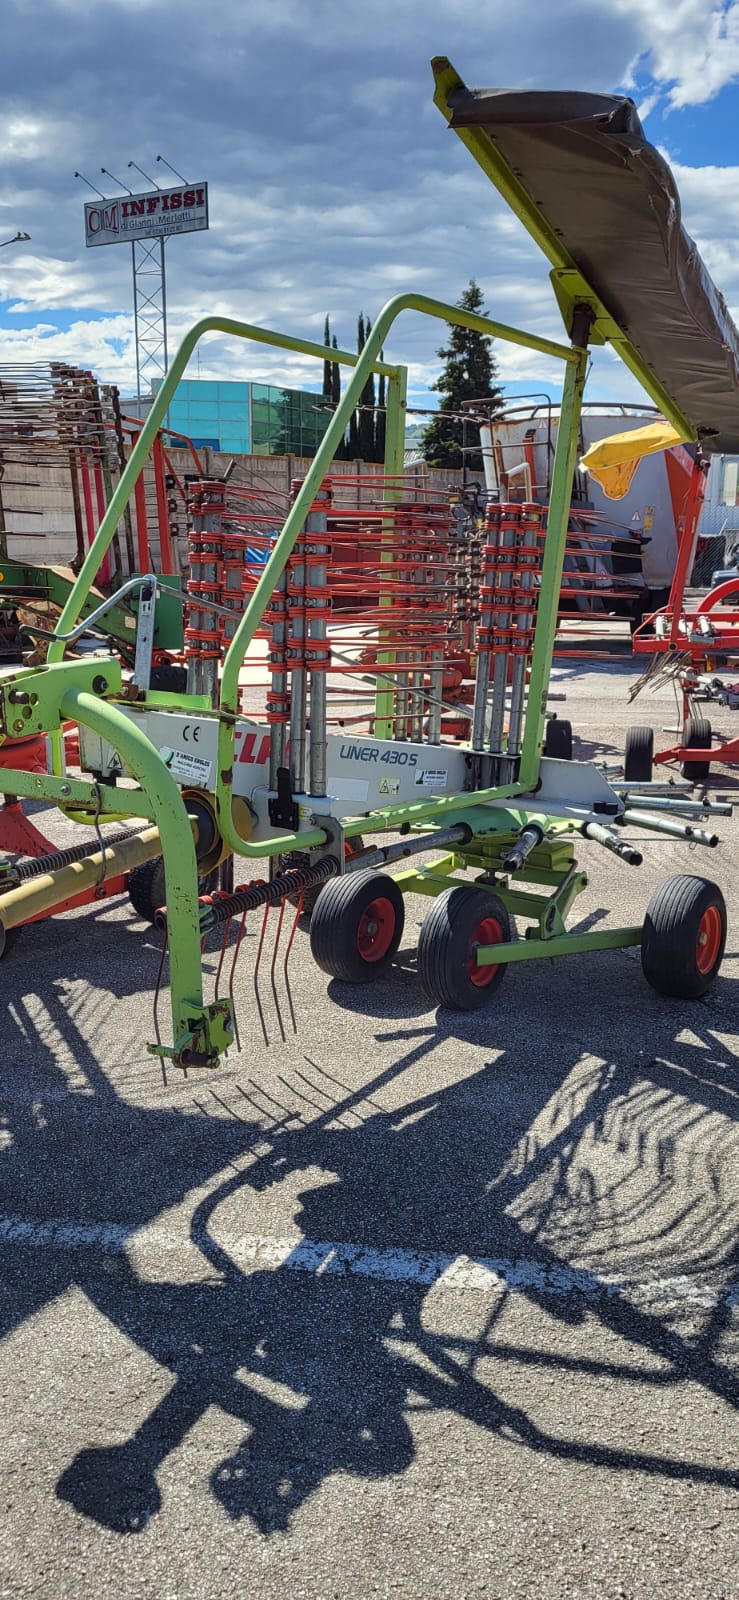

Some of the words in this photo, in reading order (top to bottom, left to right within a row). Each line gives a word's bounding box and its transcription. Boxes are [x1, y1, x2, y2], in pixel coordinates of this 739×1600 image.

[121, 189, 204, 217] INFISSI
[129, 217, 154, 228] Gianni
[183, 725, 200, 742] CE
[340, 745, 379, 762] LINER
